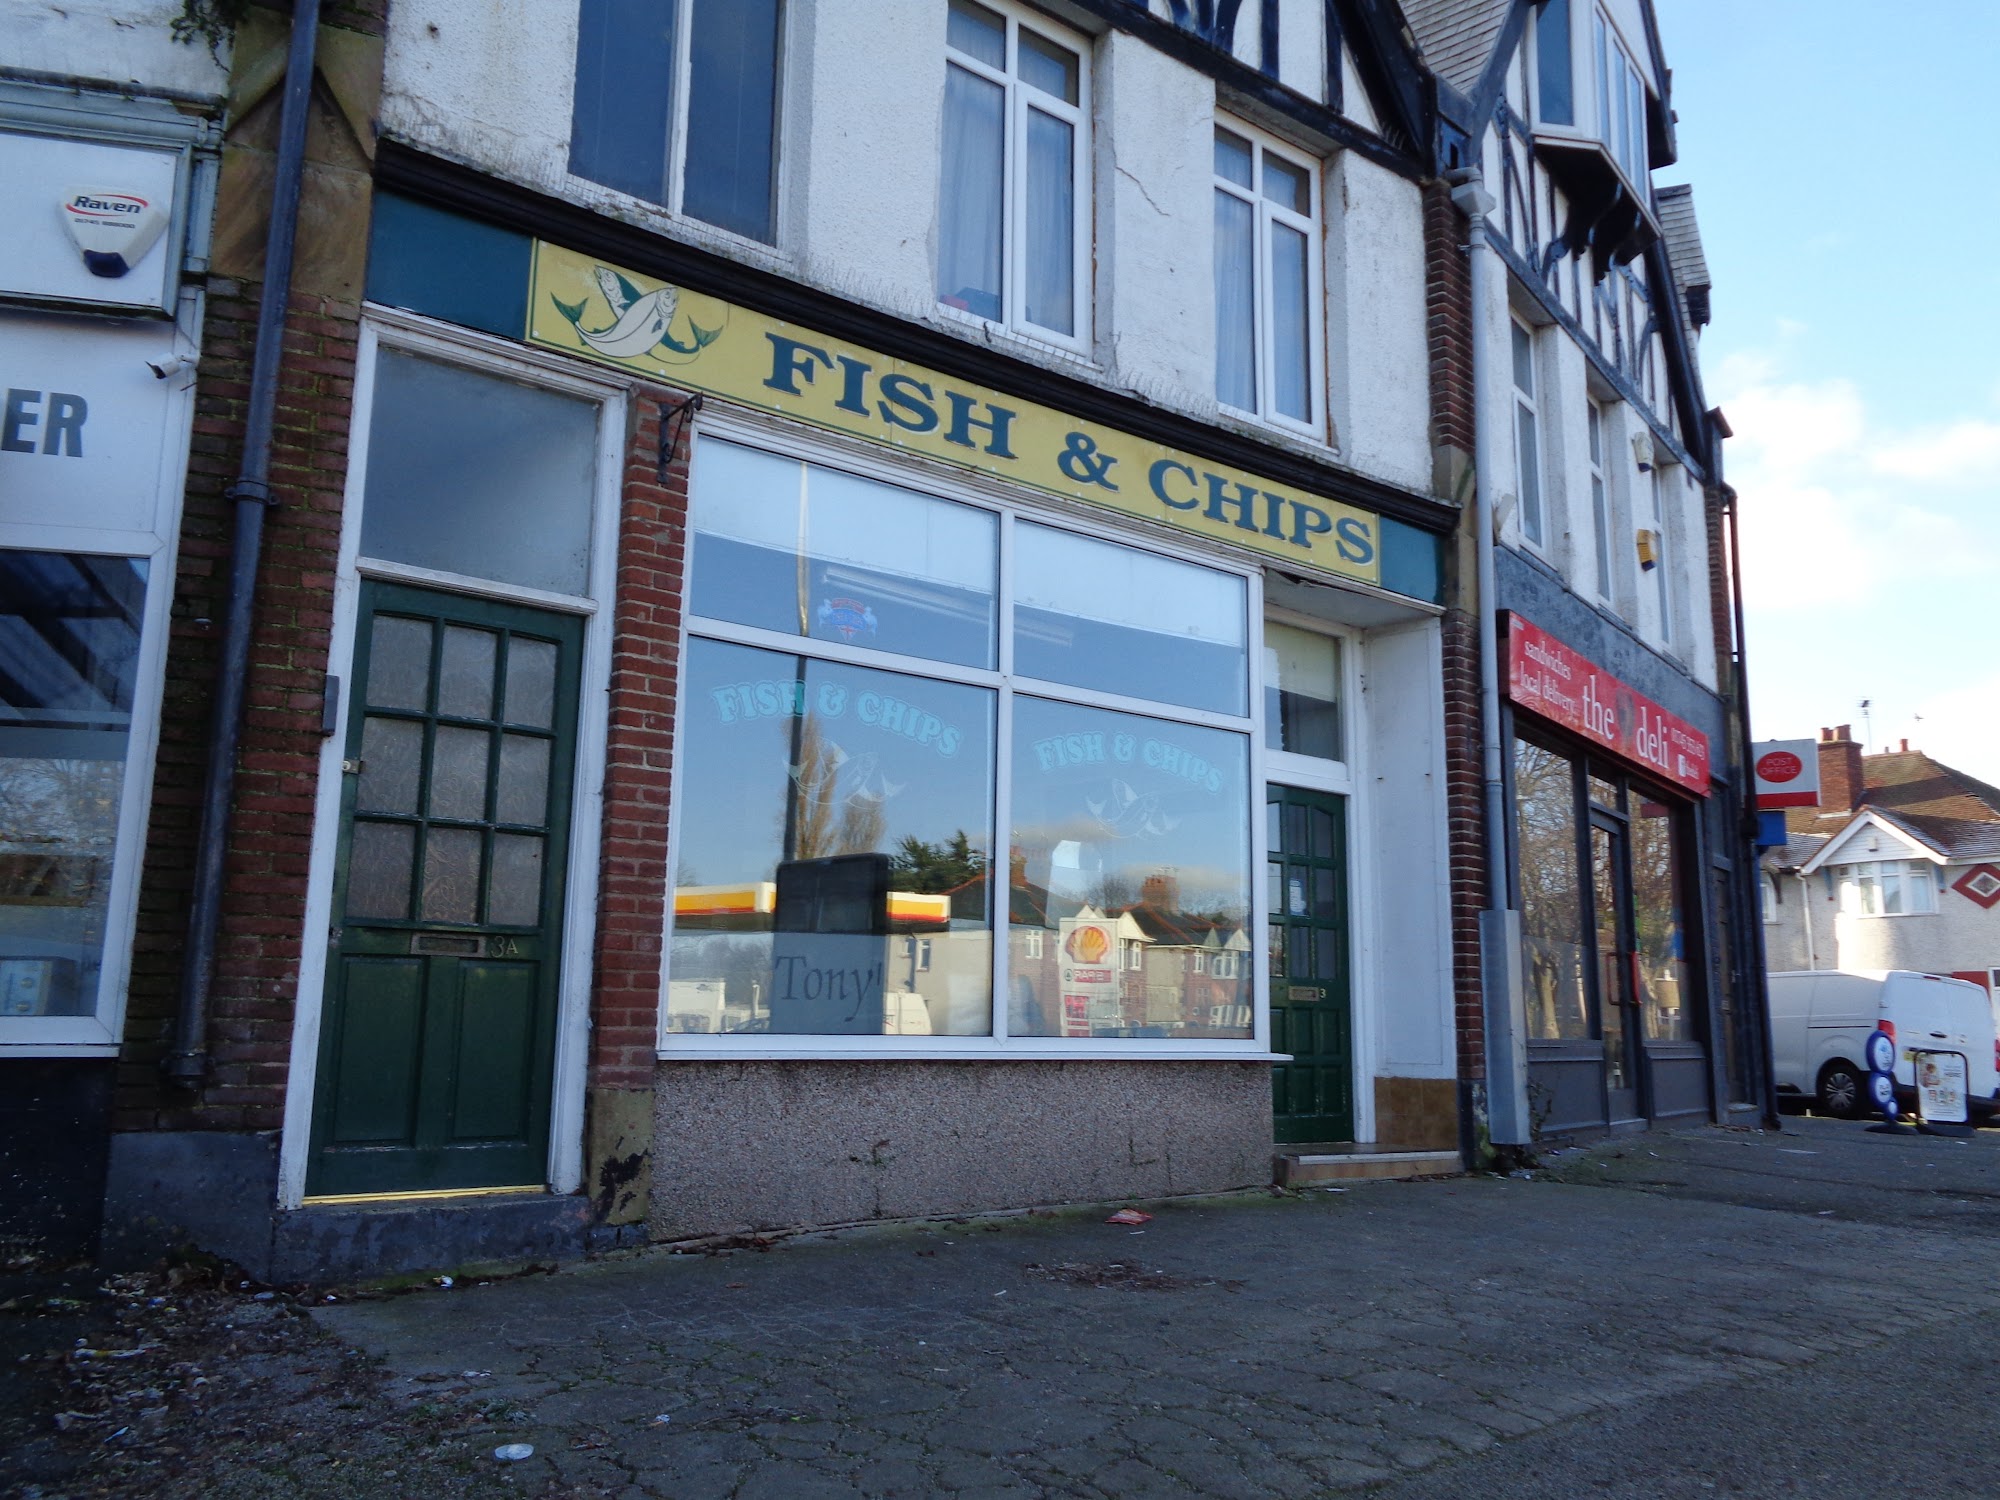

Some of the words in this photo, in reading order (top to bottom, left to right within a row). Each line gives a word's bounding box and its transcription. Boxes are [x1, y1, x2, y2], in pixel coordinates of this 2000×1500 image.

[74, 195, 141, 213] Raven
[763, 332, 1018, 460] FISH
[1057, 431, 1119, 493] &
[1149, 459, 1375, 566] CHIPS
[1524, 640, 1571, 681] sandwiches
[1520, 660, 1541, 696] local
[1543, 675, 1576, 721] delivery
[712, 679, 807, 725] FISH
[818, 681, 848, 717] &
[857, 691, 964, 759] CHIPS
[1582, 675, 1614, 740] the
[1636, 707, 1669, 769] deli
[1032, 731, 1105, 773] FISH
[1113, 732, 1137, 765] &
[1142, 738, 1226, 794] CHIPS
[1760, 766, 1797, 775] OFFICE
[1766, 758, 1792, 766] POST
[490, 935, 519, 958] 3A
[1320, 988, 1326, 998] 3
